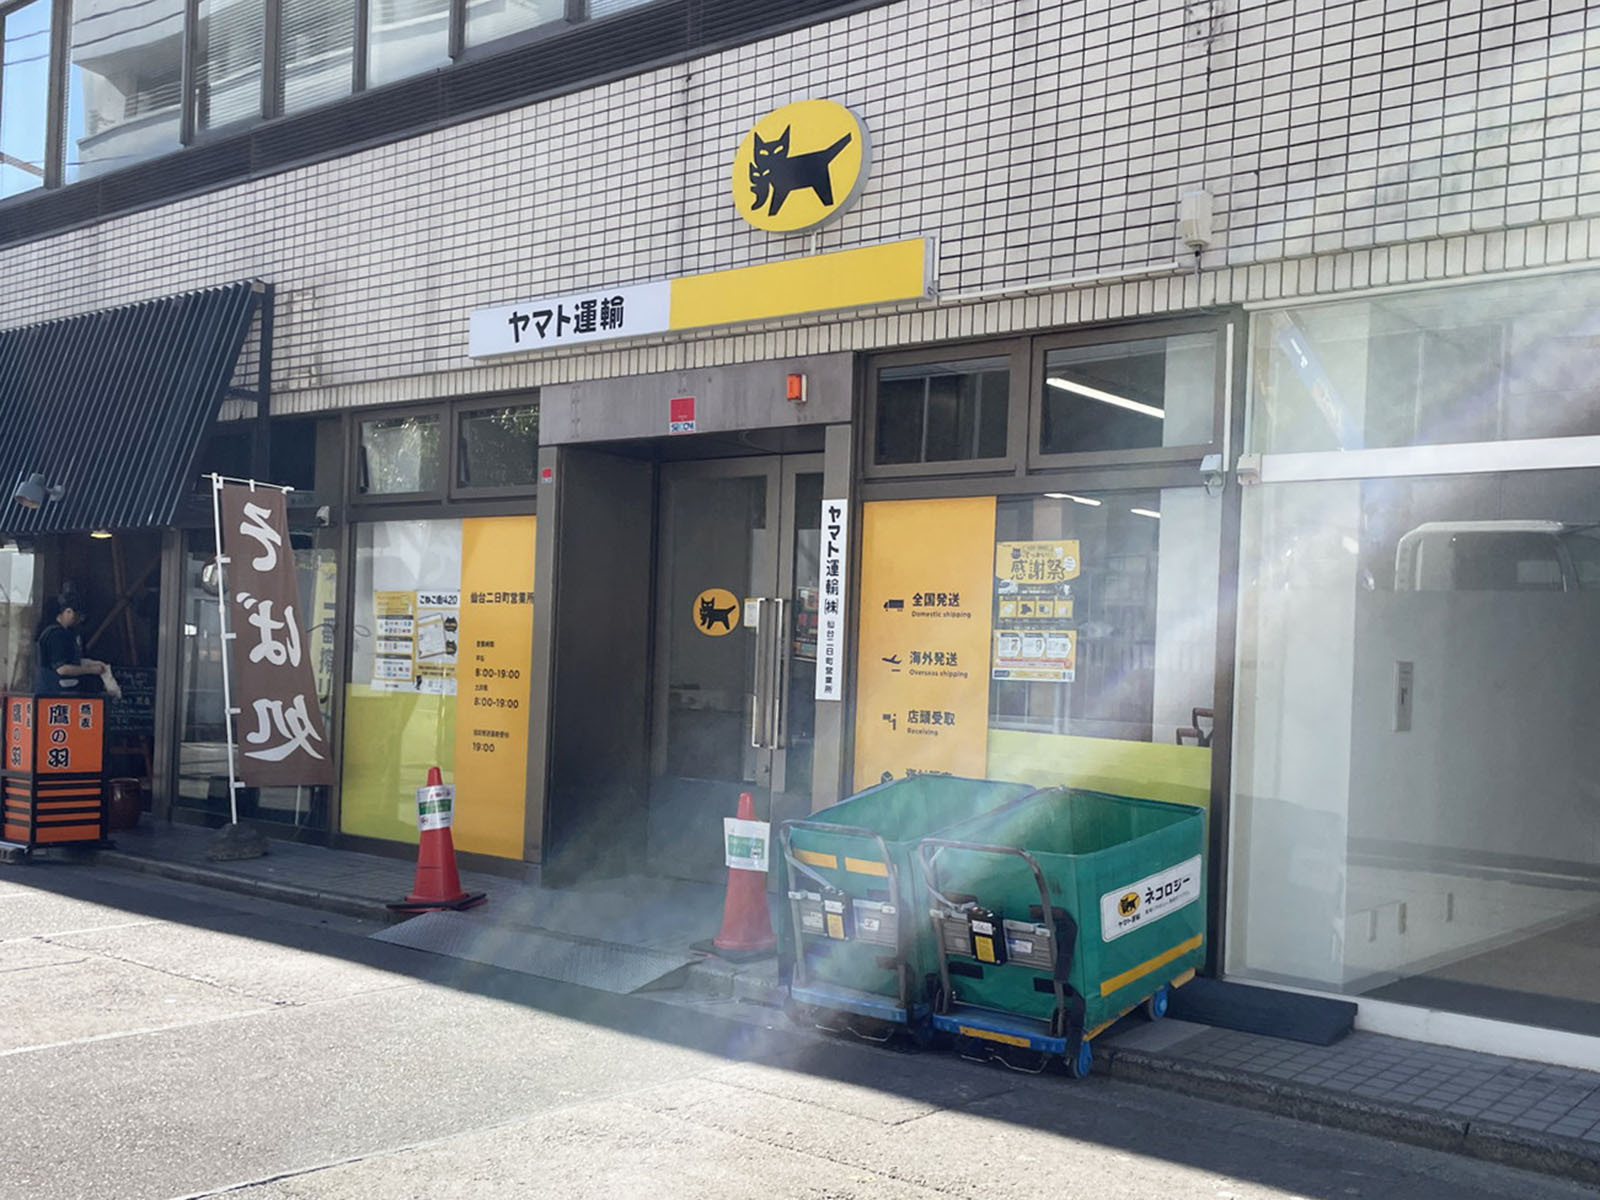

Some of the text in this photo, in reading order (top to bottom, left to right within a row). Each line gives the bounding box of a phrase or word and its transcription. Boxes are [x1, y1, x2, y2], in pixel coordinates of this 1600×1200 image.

[508, 294, 625, 344] ヤマト運輸
[1010, 559, 1066, 581] 感謝祭
[912, 592, 960, 608] 全国発送
[911, 610, 971, 619] Domestic shipping
[909, 651, 958, 667] 海外発送
[909, 668, 968, 679] Overseas shipping
[907, 710, 956, 727] 店頭受取
[48, 704, 70, 768] 鷹の羽
[907, 727, 939, 737] Receiving
[473, 741, 495, 753] 19:00
[1144, 877, 1191, 905] ネコロジー
